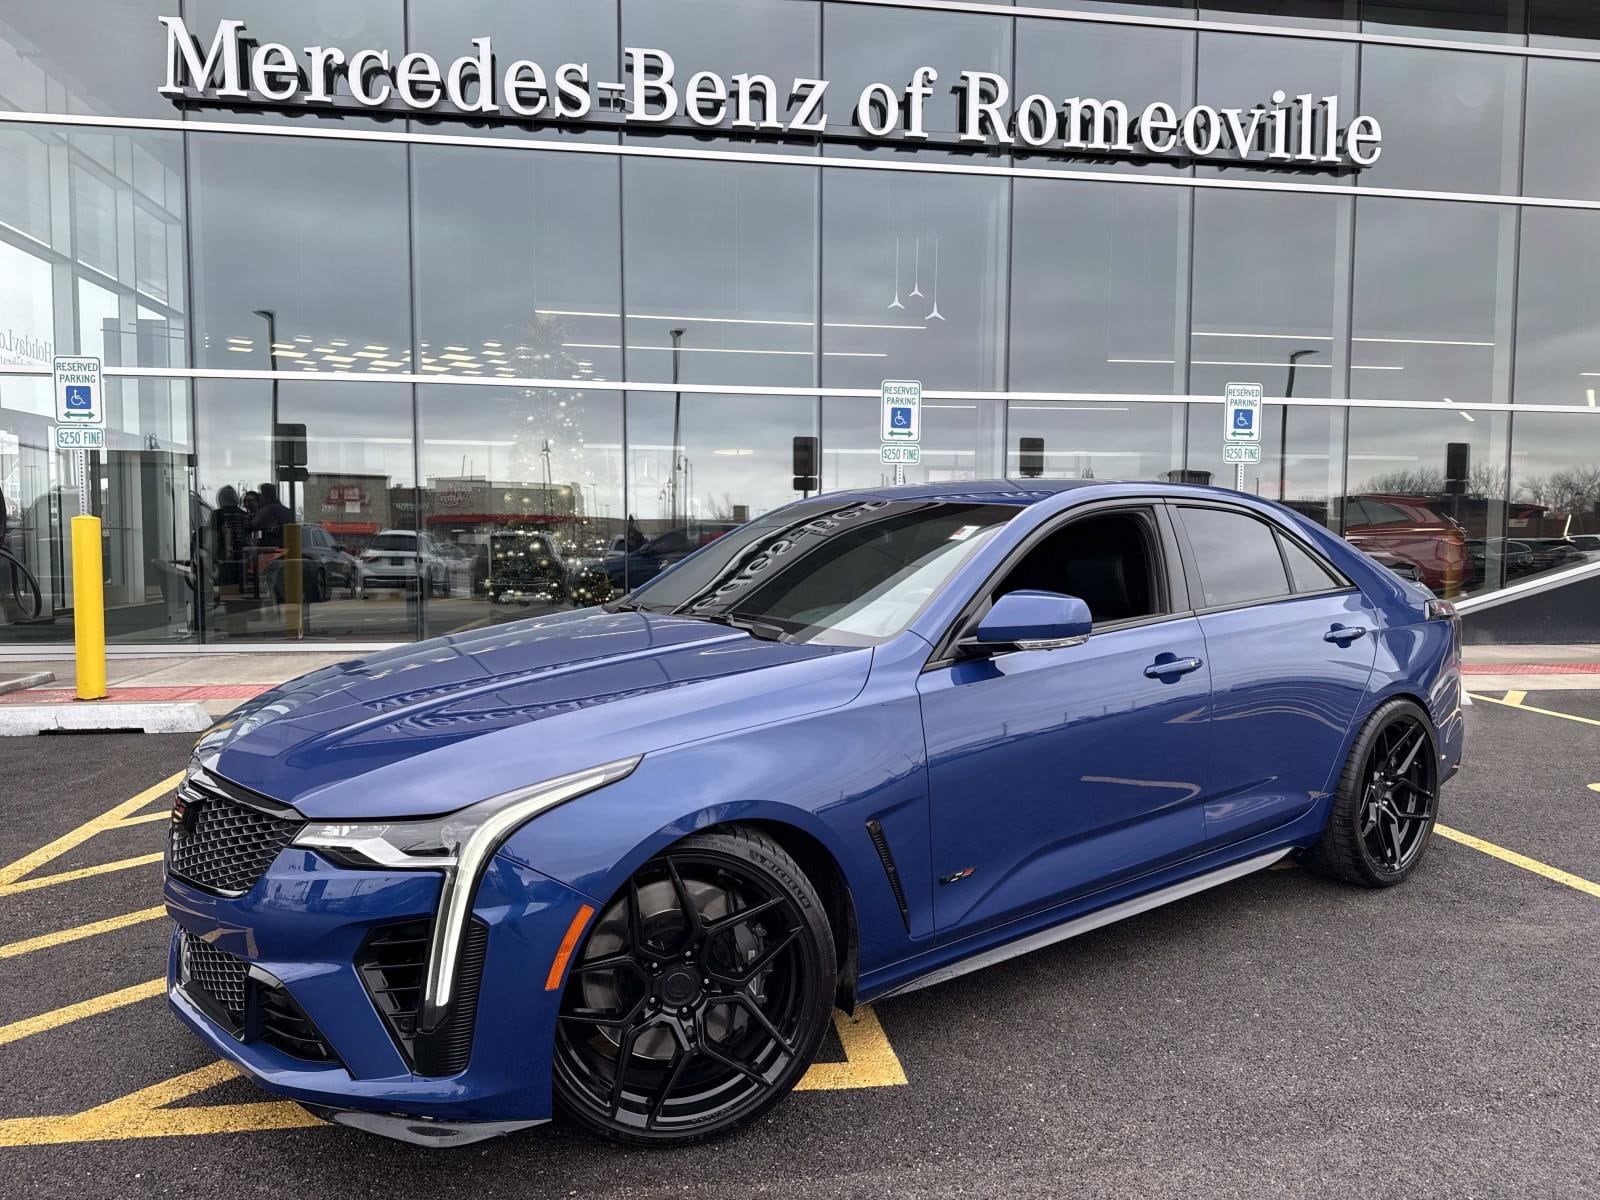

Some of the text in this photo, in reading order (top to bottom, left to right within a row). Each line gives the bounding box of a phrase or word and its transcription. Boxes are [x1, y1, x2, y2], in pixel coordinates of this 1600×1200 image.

[158, 16, 1382, 165] Mercedes-Benz of Romeoville
[56, 362, 98, 372] RESERVED
[59, 374, 96, 384] PARKING
[884, 386, 919, 395] RESERVED
[1229, 388, 1260, 397] RESERVED
[886, 397, 916, 406] PARKING
[1230, 399, 1258, 407] PARKING
[59, 431, 101, 445] $250 FINE
[883, 447, 918, 460] $250 FINE
[1226, 448, 1258, 460] $250 FINE
